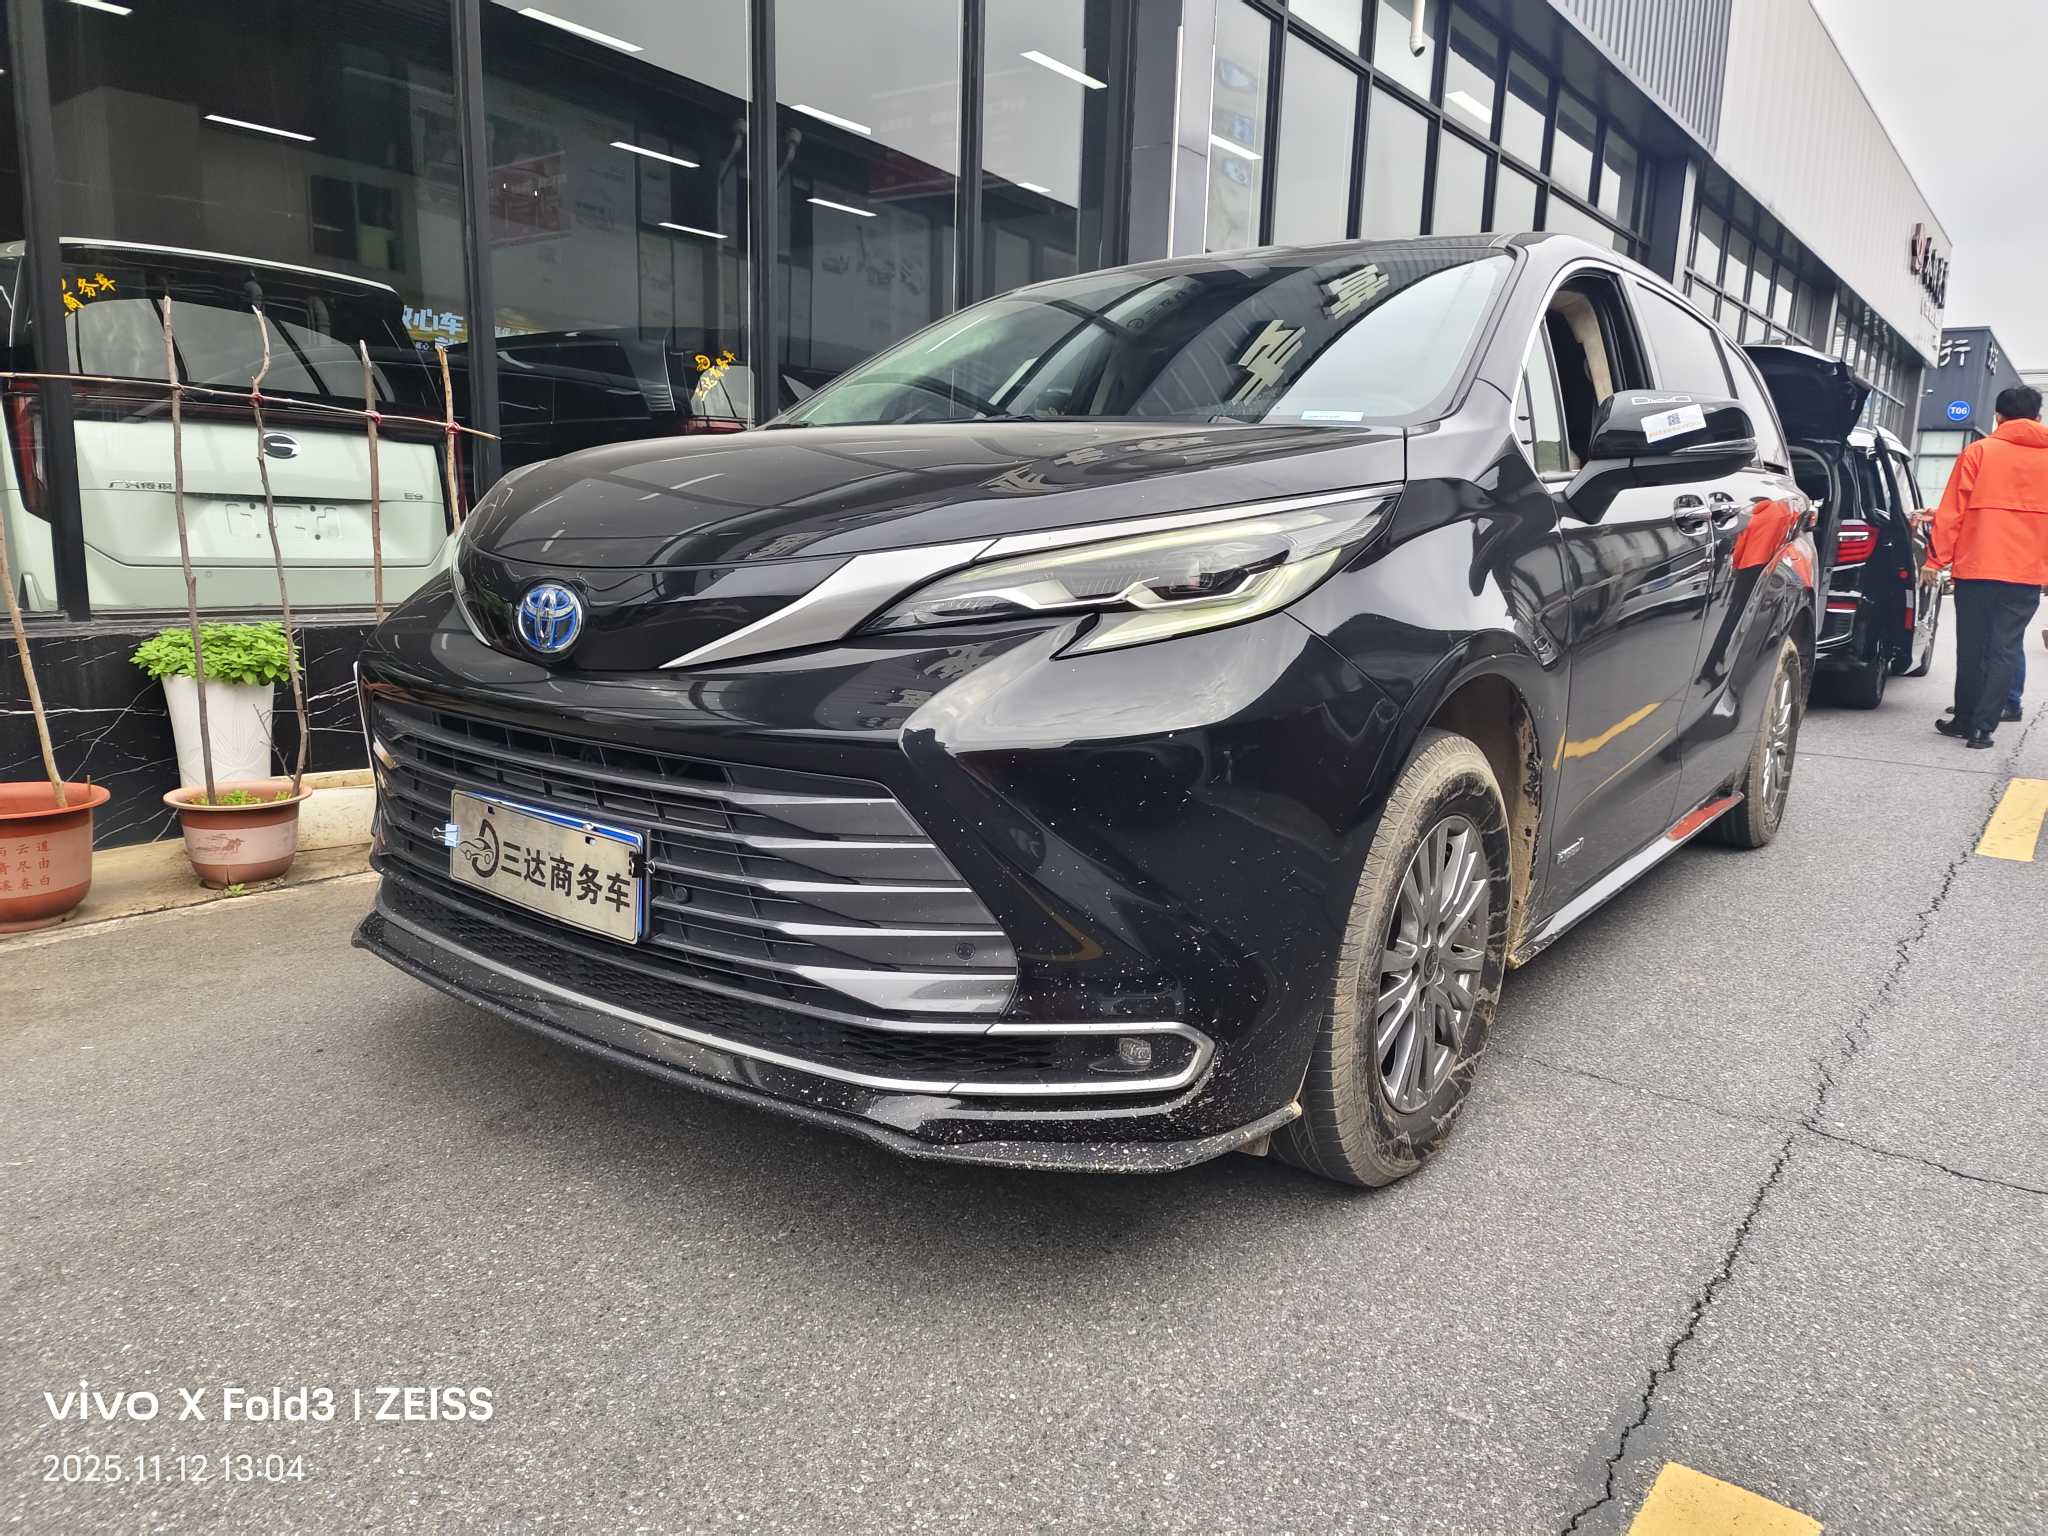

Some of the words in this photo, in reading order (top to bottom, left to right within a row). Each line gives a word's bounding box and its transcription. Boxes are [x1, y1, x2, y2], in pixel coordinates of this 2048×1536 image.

[1950, 405, 1968, 415] T06
[501, 841, 630, 912] 三达商务车
